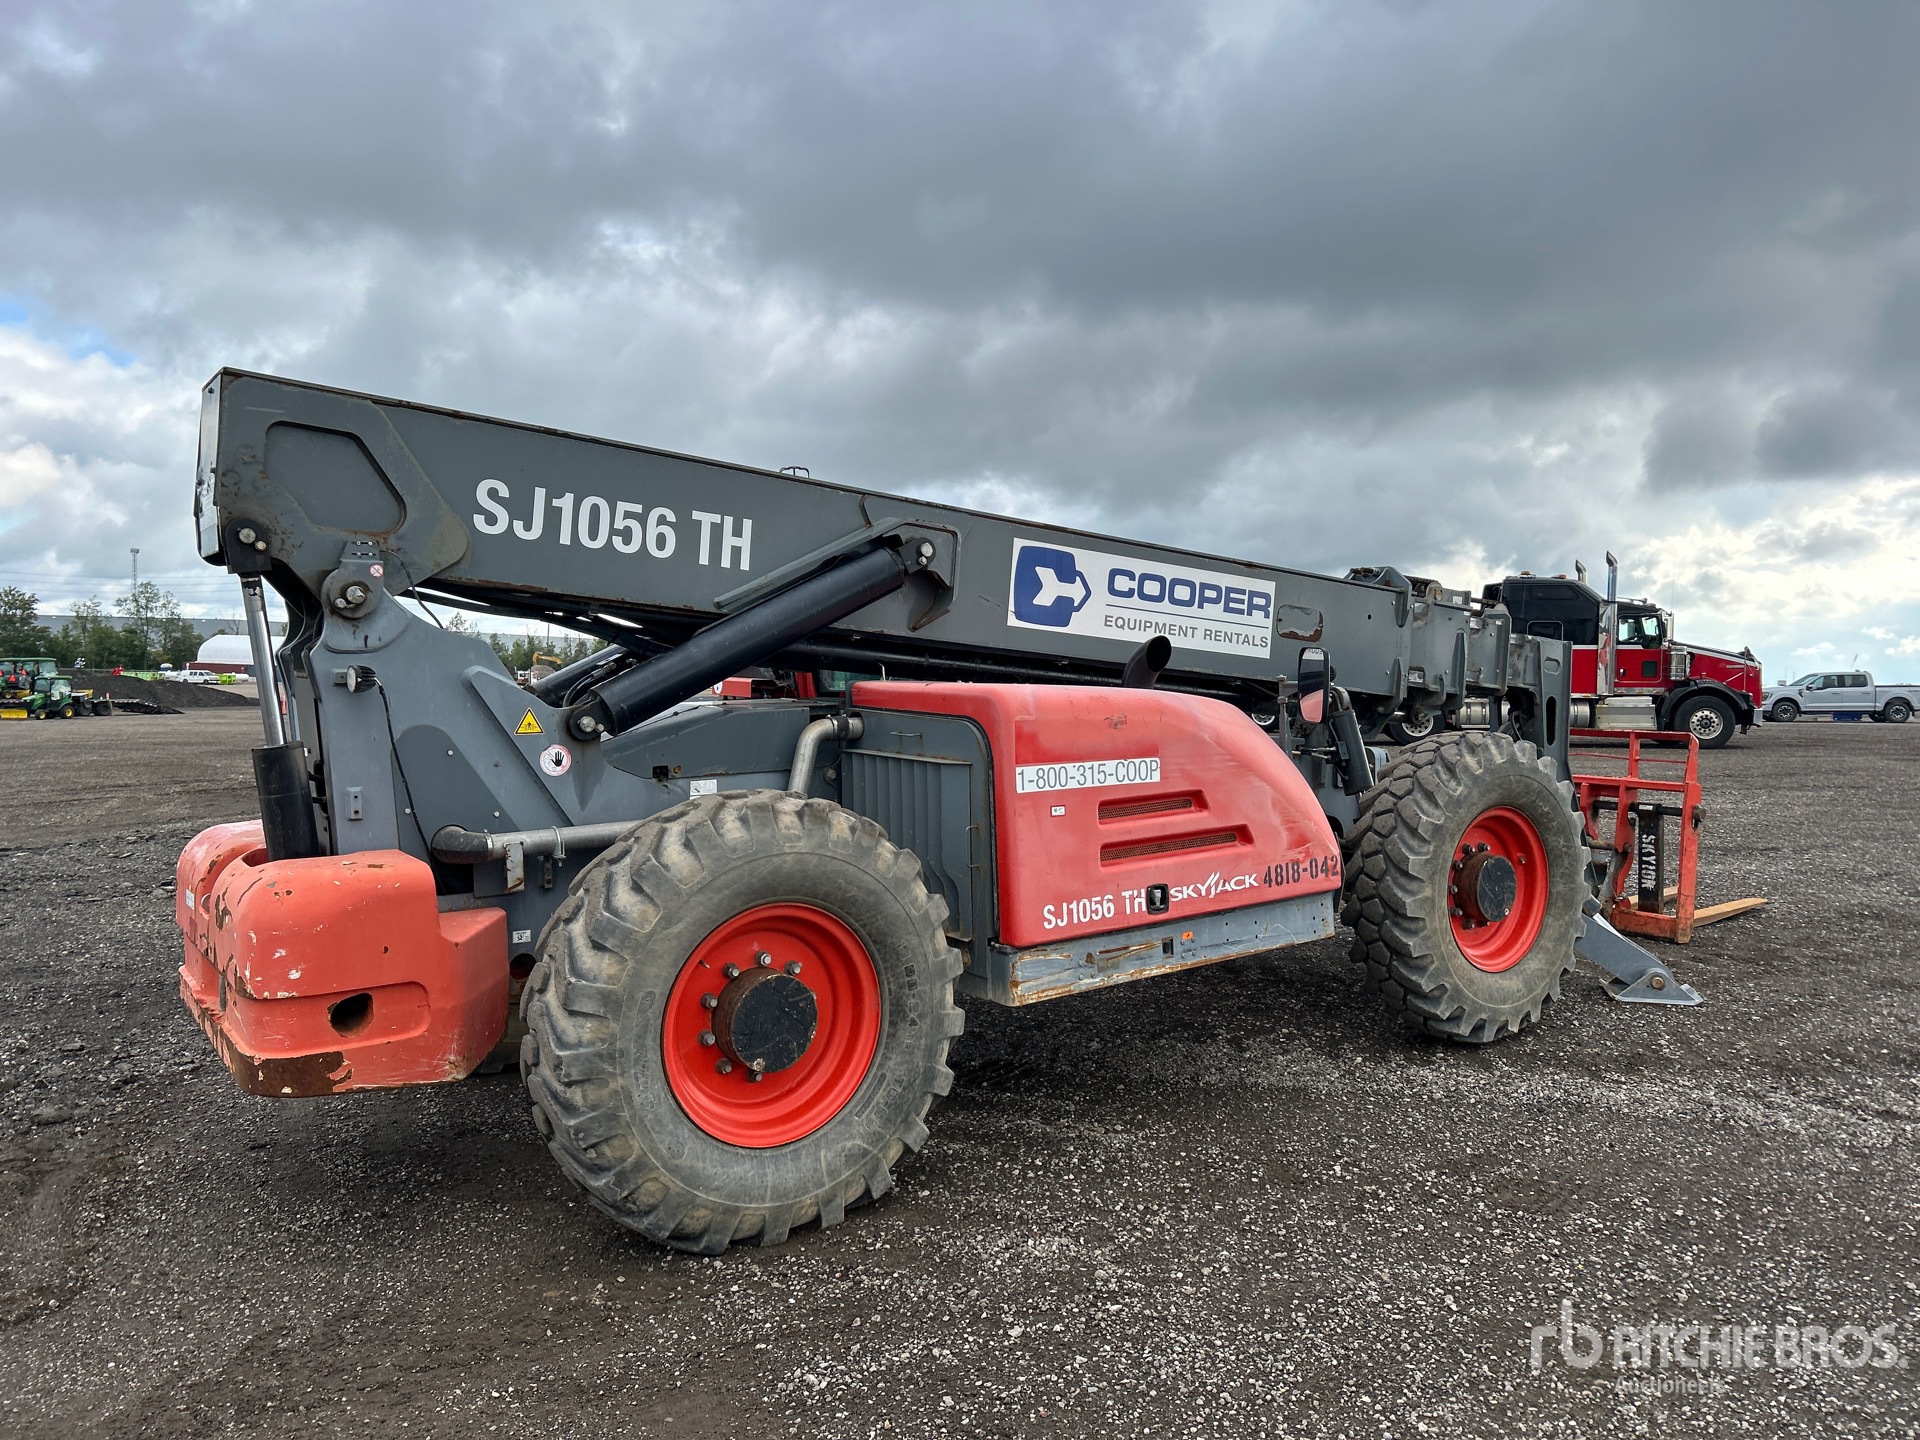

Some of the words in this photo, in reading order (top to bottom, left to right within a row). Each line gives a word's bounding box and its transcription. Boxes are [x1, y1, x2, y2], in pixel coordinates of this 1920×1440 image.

[472, 478, 677, 559] SJ1056
[691, 510, 753, 571] TH
[1107, 567, 1272, 620] COOPER
[1103, 614, 1198, 639] EQUIPMENT
[1203, 628, 1269, 648] RENTALS
[1017, 759, 1159, 791] 1-800-315-COOP
[1169, 871, 1260, 901] SKYJACK
[1263, 854, 1340, 889] 4818-042
[1042, 894, 1115, 930] SJ1056
[1121, 888, 1147, 915] TH
